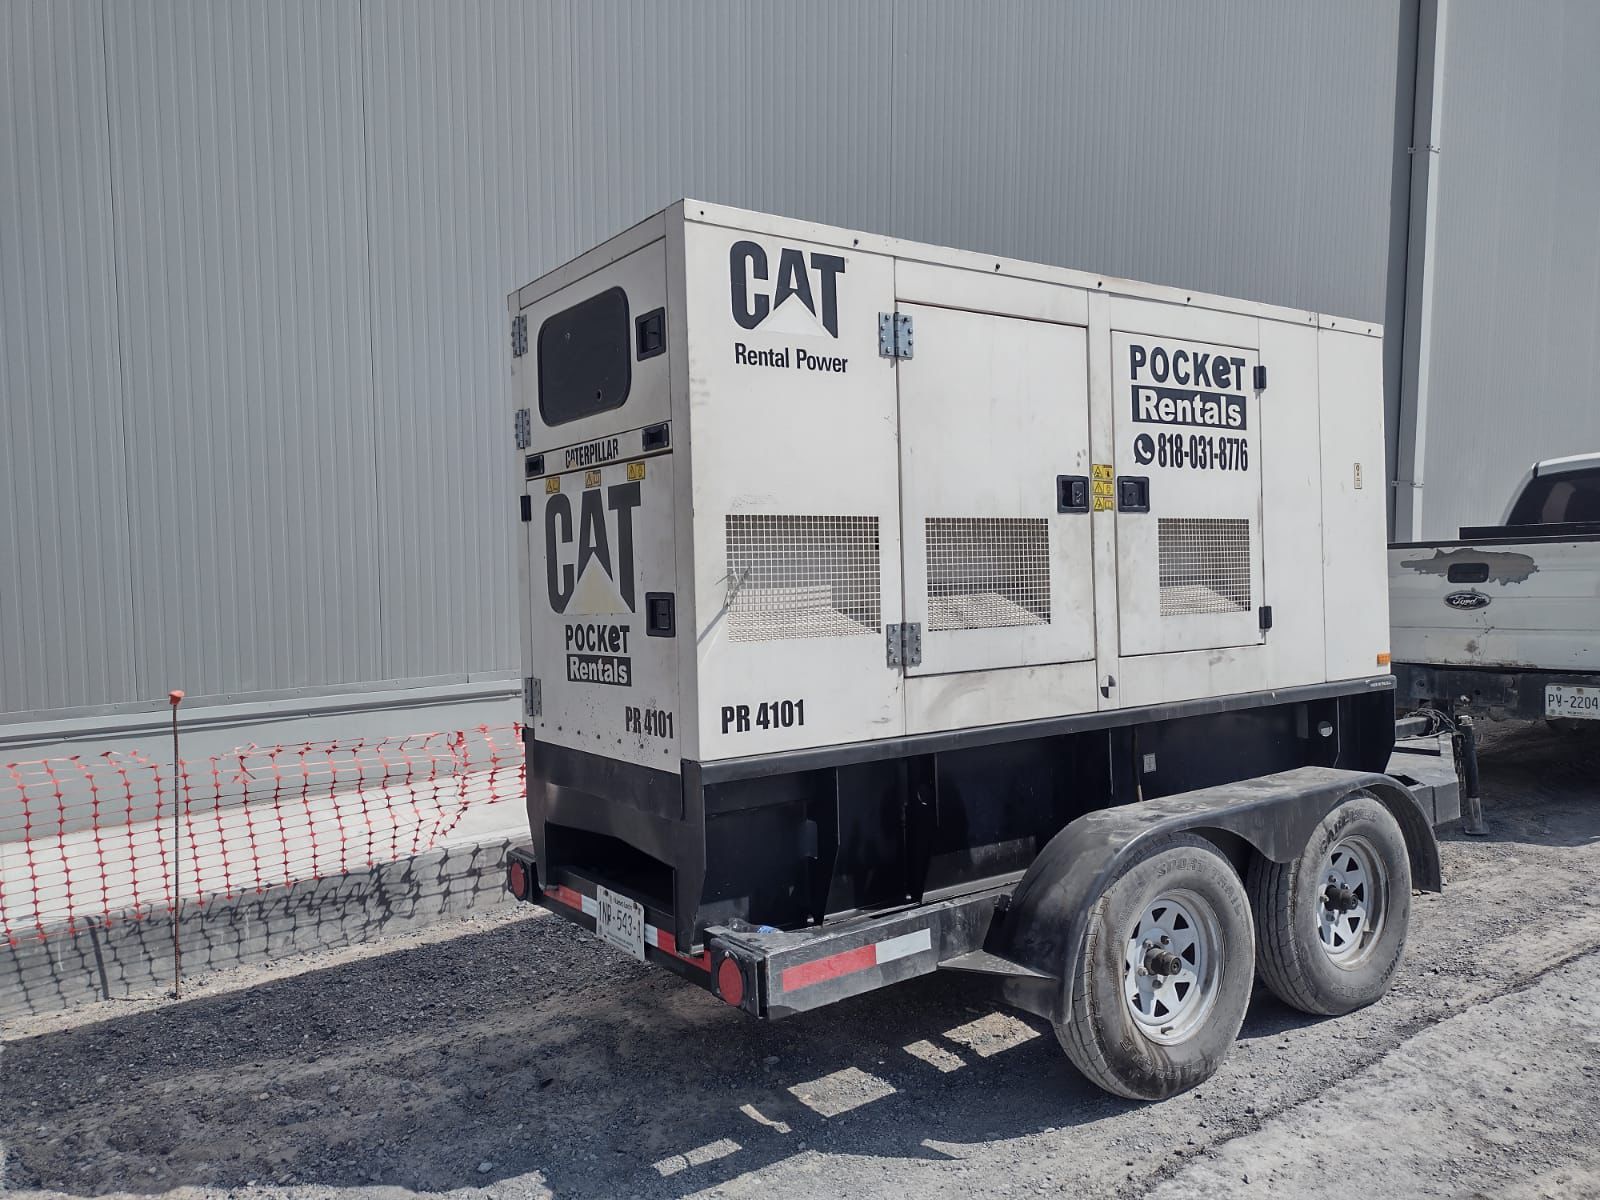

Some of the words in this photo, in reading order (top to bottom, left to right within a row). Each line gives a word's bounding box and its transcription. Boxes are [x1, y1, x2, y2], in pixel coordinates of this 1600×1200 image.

[729, 240, 846, 339] CAT
[735, 342, 790, 368] Rental
[796, 348, 848, 373] Power
[1138, 388, 1242, 427] Rentals
[565, 438, 619, 469] CATERPILLAR
[1158, 432, 1248, 471] 818-031-8776
[545, 481, 642, 614] CAT
[569, 656, 628, 684] Rentals
[721, 703, 751, 734] PR
[756, 699, 804, 730] 4101
[1548, 693, 1599, 710] PV-2204
[625, 705, 642, 734] PR
[644, 708, 674, 739] 4101
